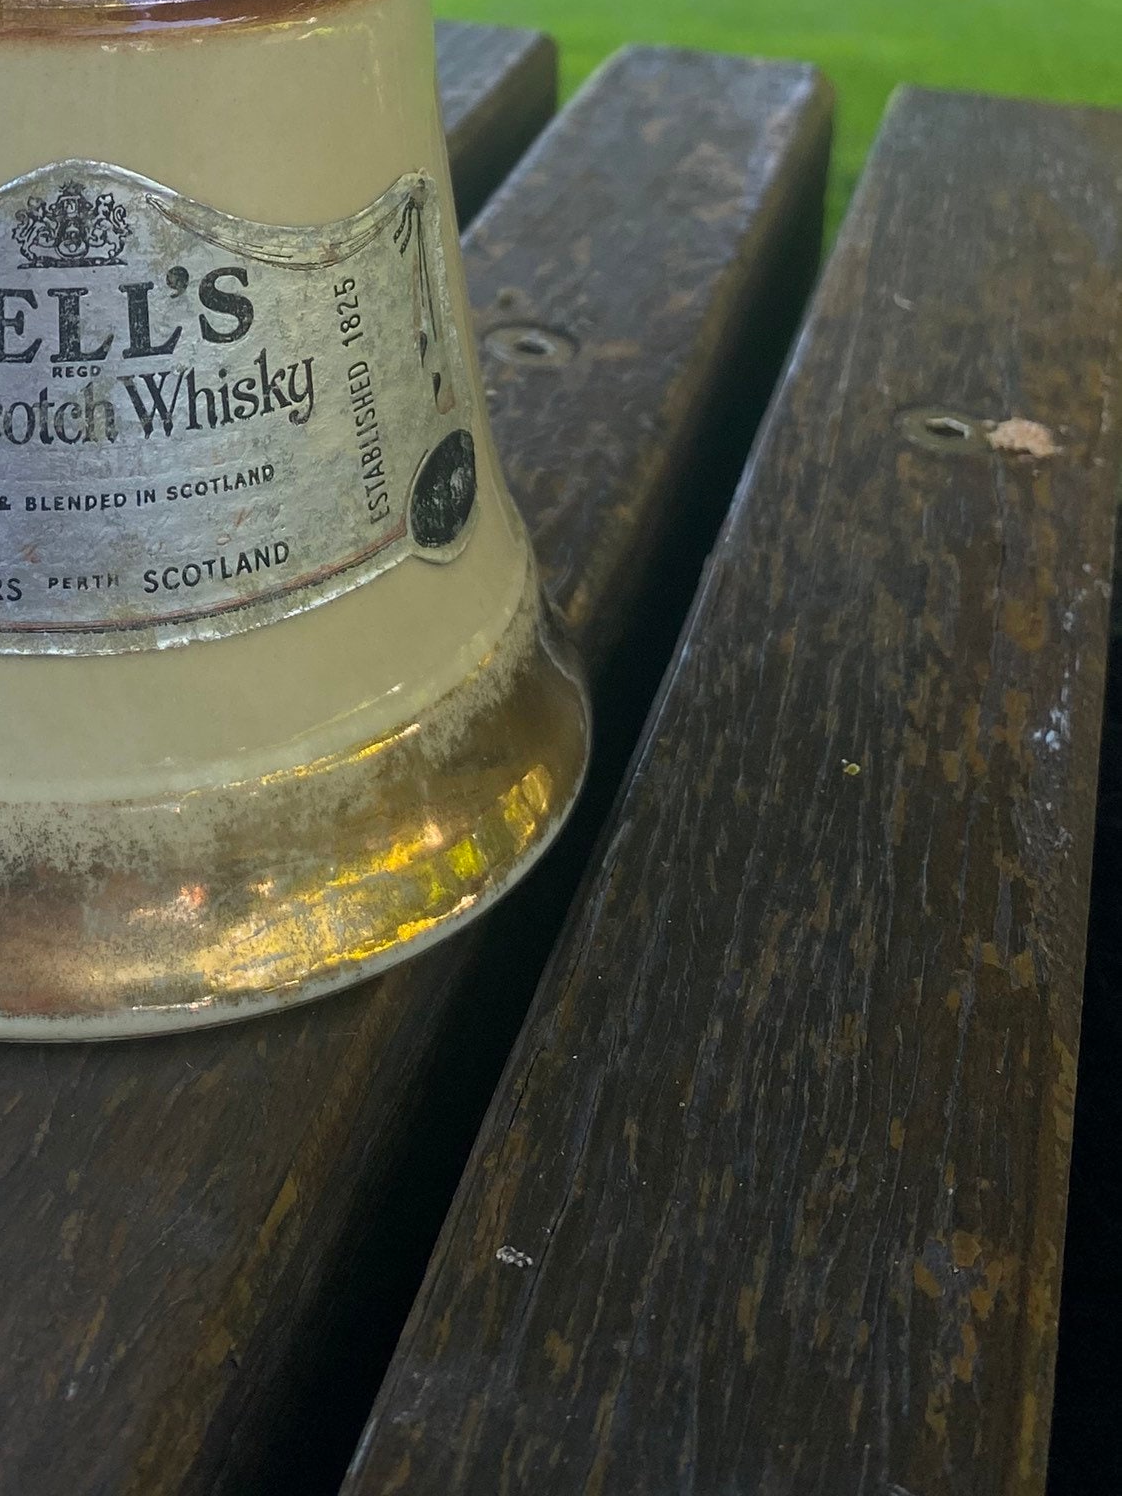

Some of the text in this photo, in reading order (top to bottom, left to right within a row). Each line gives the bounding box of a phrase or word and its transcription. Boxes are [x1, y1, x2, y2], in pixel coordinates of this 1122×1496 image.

[52, 365, 101, 378] REGD
[117, 347, 314, 439] Whisky
[334, 278, 390, 525] ESTABLISHED 1825
[25, 493, 127, 512] BLENDED
[136, 490, 156, 507] IN
[166, 464, 274, 501] SCOTLAND
[48, 573, 119, 589] PERTH
[143, 541, 290, 593] SCOTLAND
